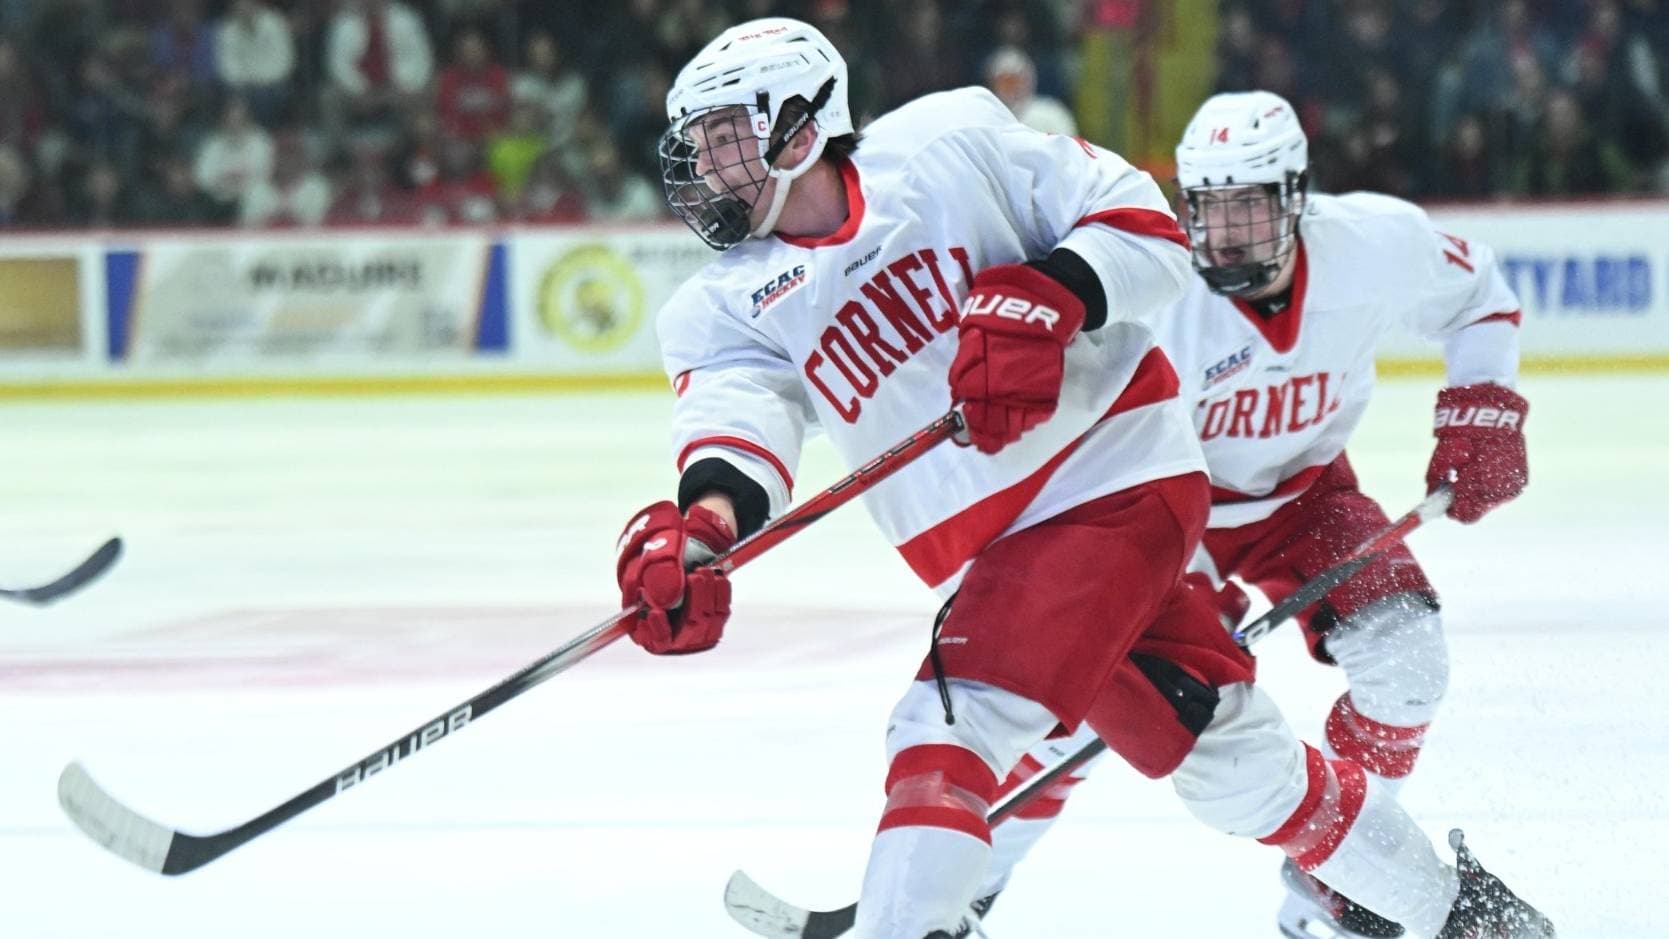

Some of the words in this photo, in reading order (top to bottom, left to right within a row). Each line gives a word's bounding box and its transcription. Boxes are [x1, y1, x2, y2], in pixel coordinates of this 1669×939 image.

[757, 120, 767, 132] C
[1209, 127, 1229, 146] 14
[751, 265, 805, 304] ECAC
[761, 275, 806, 310] HOCKEY
[1198, 371, 1347, 442] ORNEL
[1434, 406, 1521, 432] AUER
